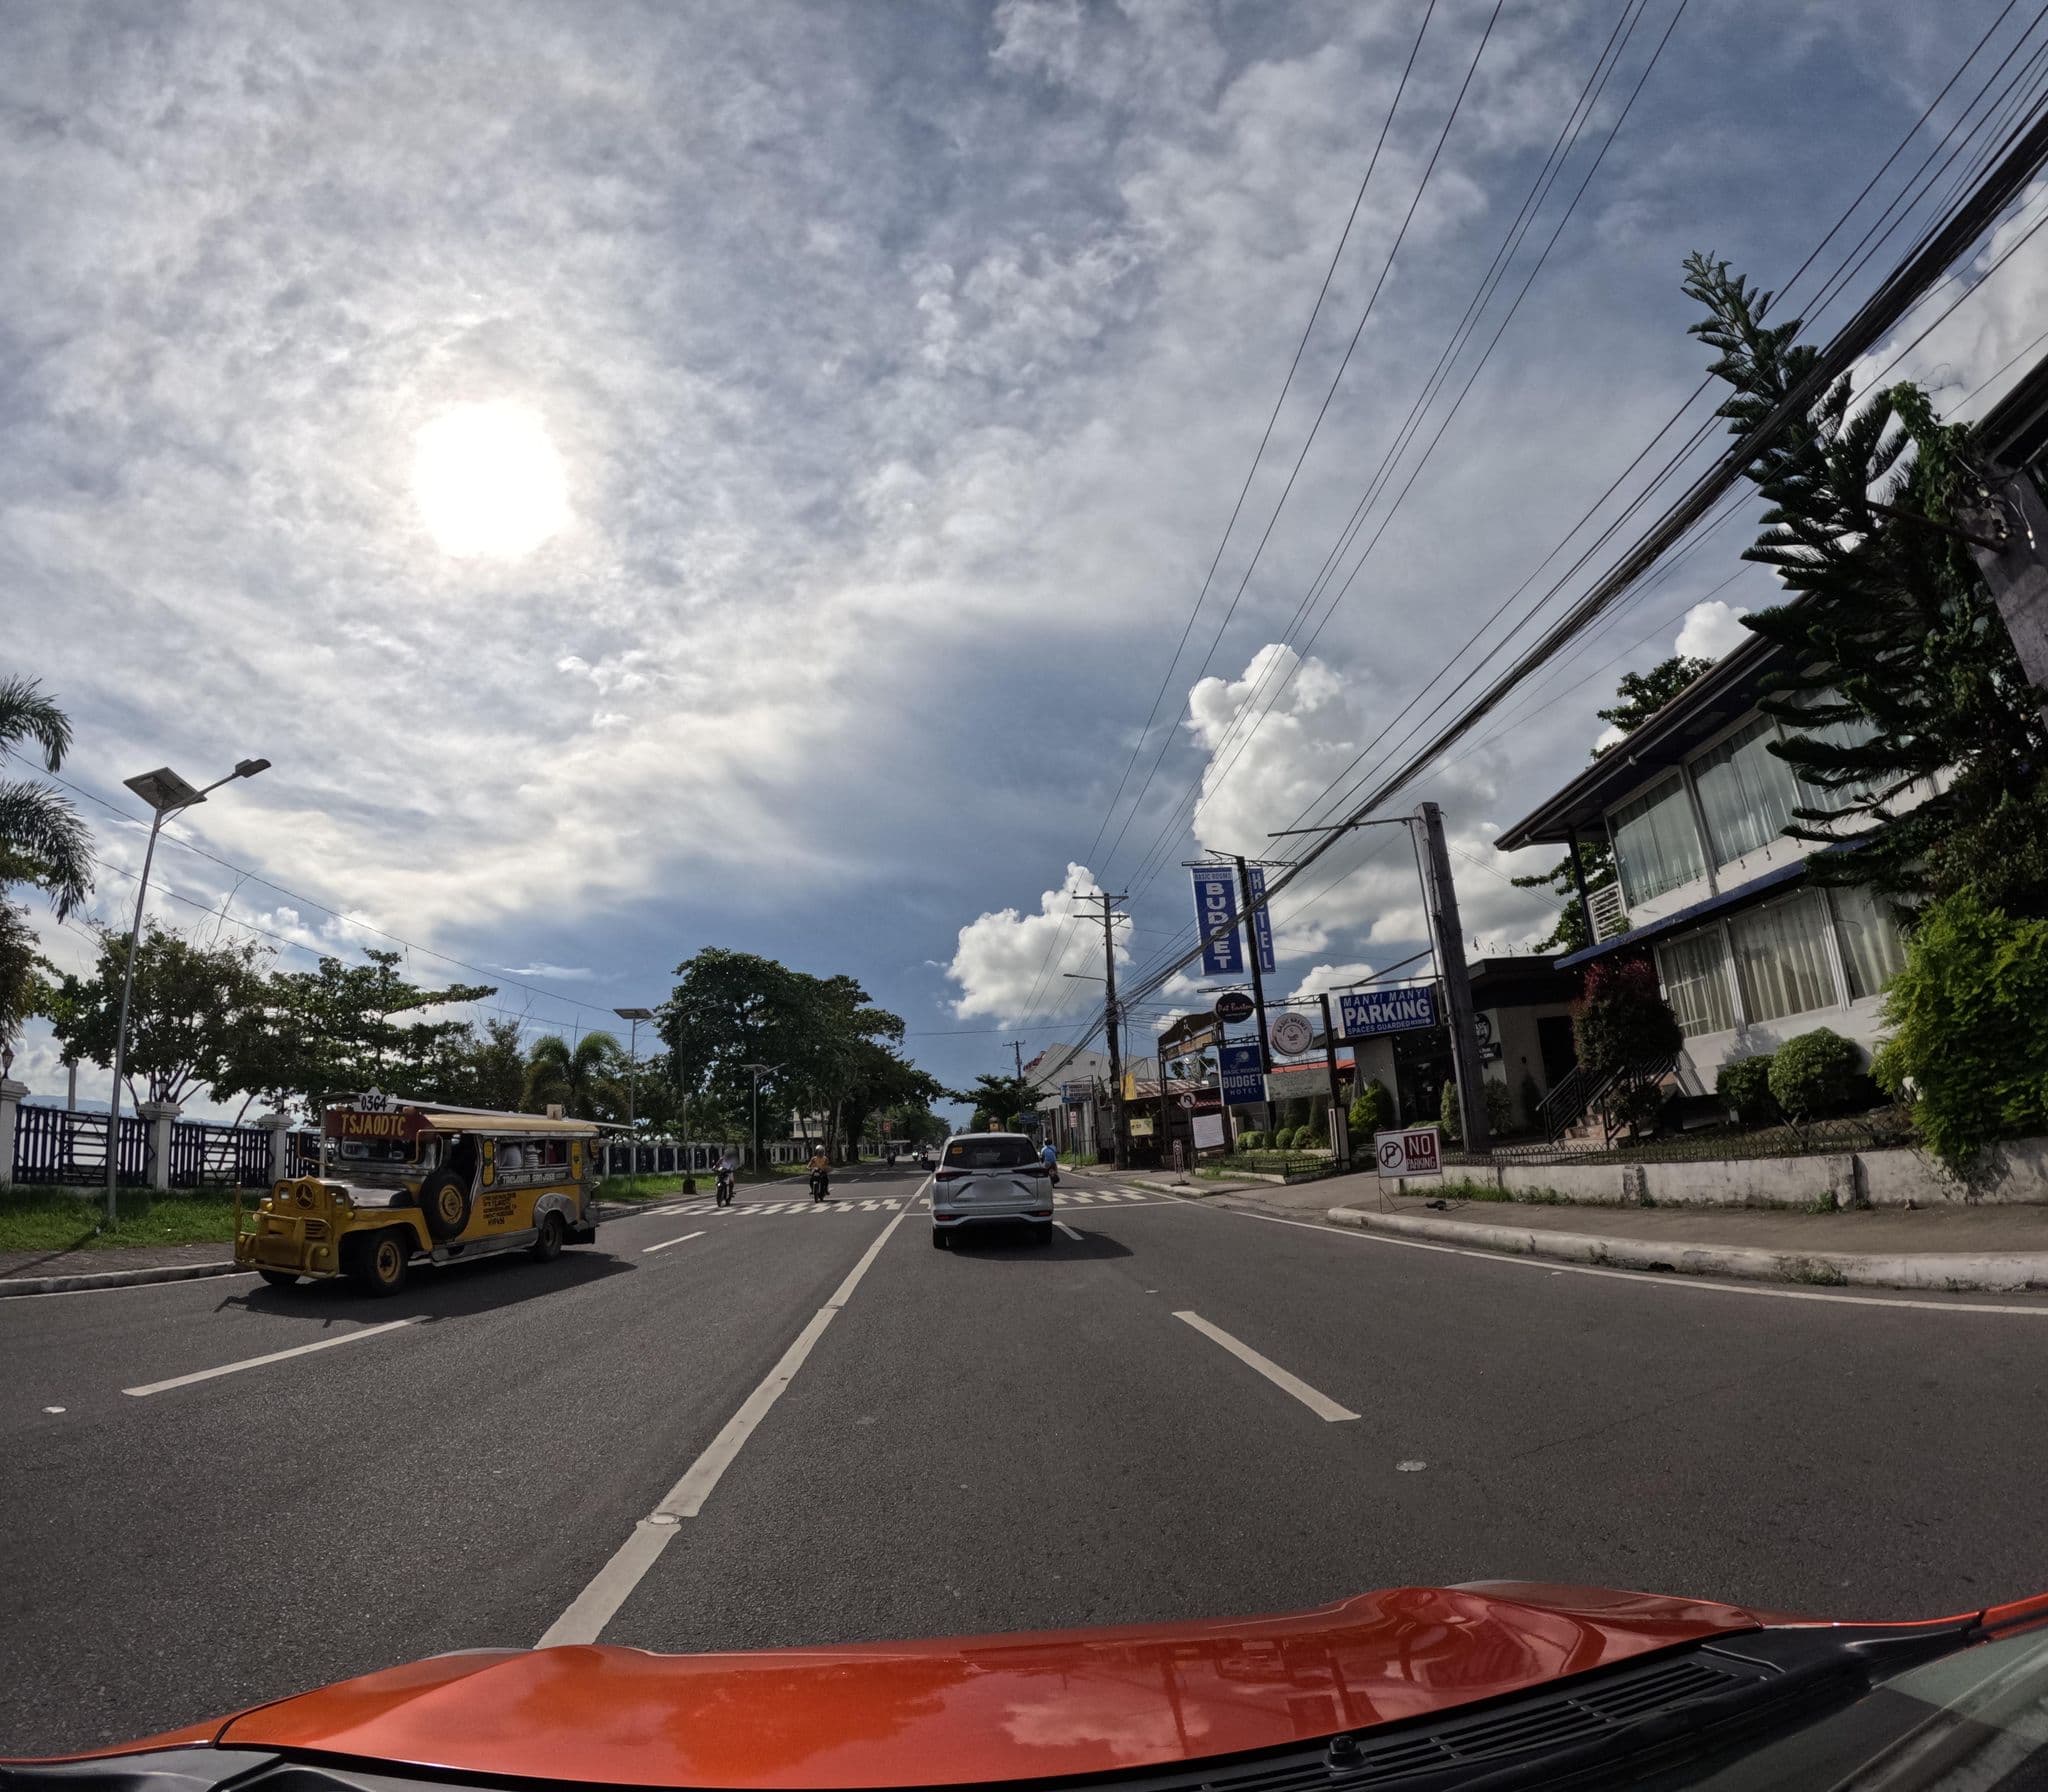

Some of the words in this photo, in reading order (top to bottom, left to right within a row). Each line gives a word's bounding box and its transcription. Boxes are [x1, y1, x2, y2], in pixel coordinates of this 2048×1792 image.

[1206, 883, 1232, 969] BUDGET
[1344, 998, 1430, 1027] PARKING
[1347, 1024, 1376, 1035] SPACES
[1376, 1020, 1410, 1031] GUARDED
[1222, 1074, 1262, 1089] BUDGET
[1230, 1087, 1257, 1096] HOTEL
[1408, 1135, 1431, 1156] NO
[1406, 1156, 1436, 1170] PARKING
